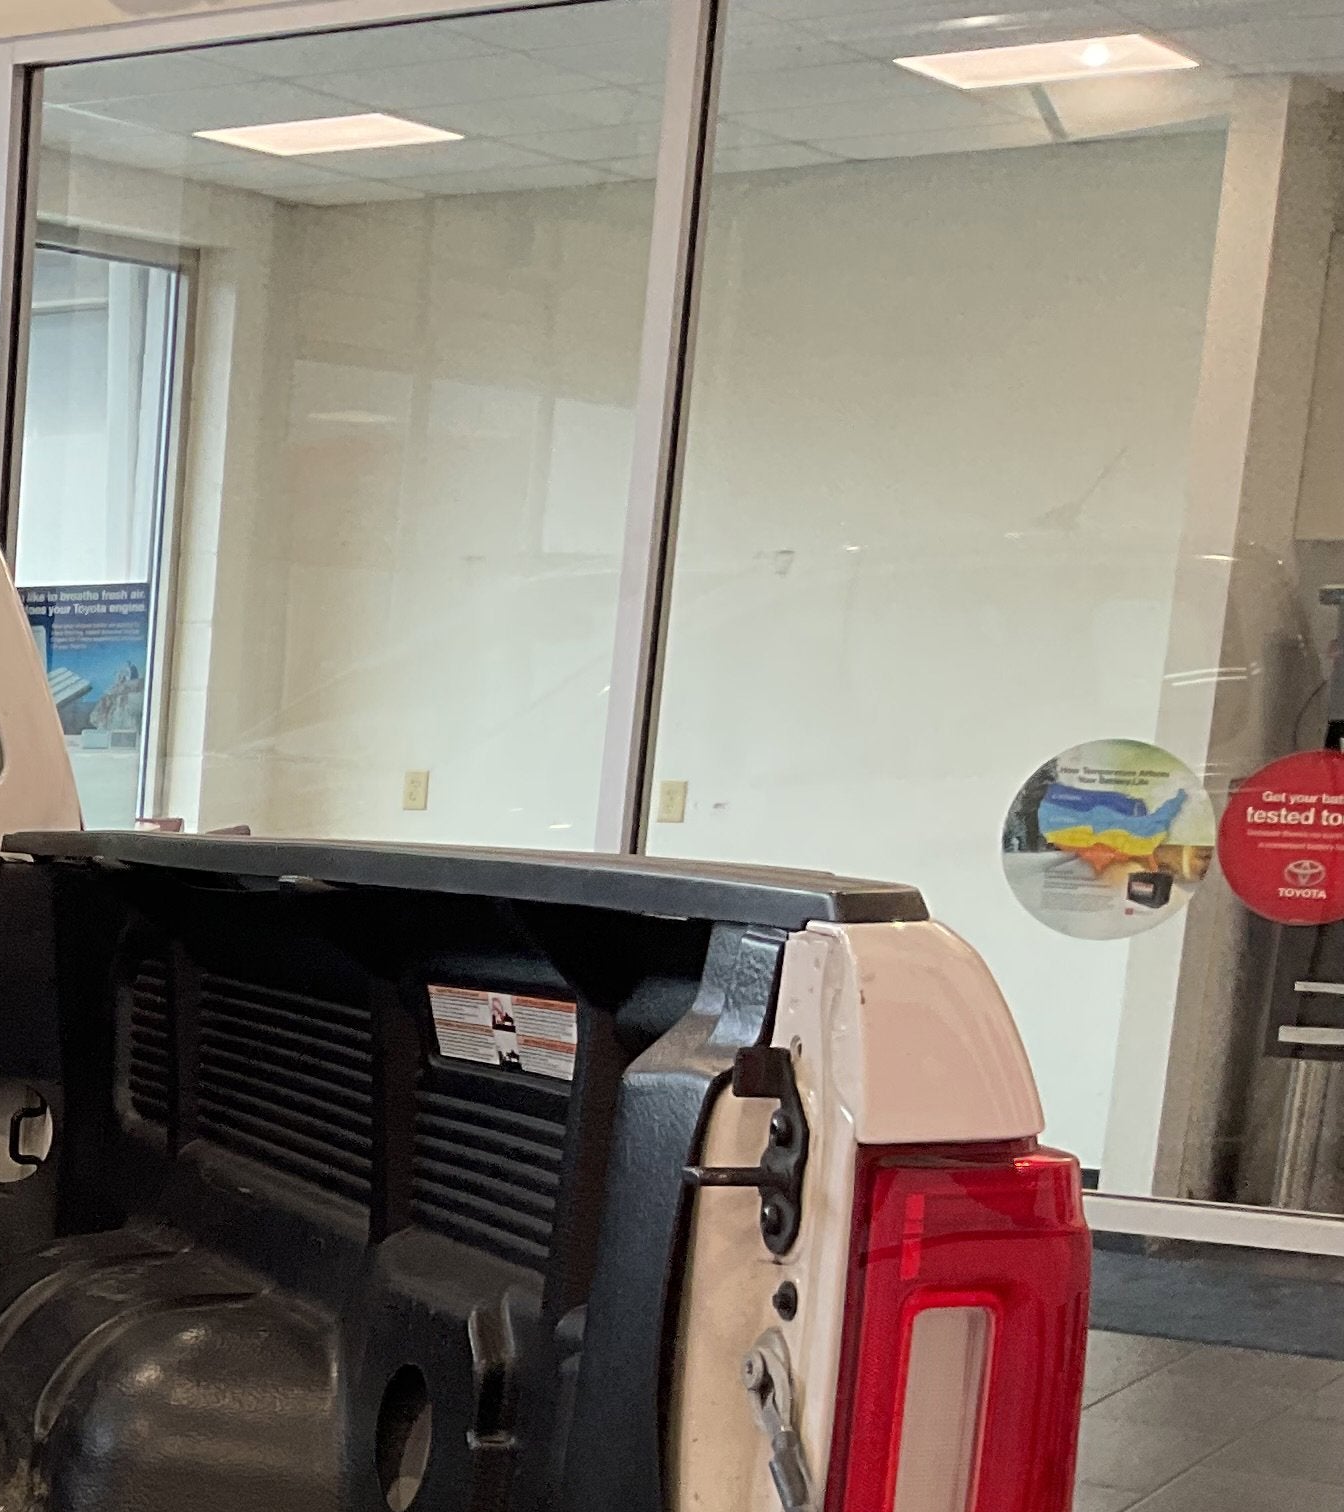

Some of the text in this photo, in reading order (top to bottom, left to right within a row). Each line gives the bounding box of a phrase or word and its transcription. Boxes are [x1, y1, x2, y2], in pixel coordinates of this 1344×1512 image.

[47, 591, 58, 602] to
[101, 589, 128, 600] fresh
[48, 605, 71, 617] your
[73, 603, 107, 616] Toyota
[1262, 790, 1286, 803] Get
[1289, 793, 1319, 805] your
[1246, 805, 1344, 826] tested to
[1278, 887, 1327, 900] TOYOTA
